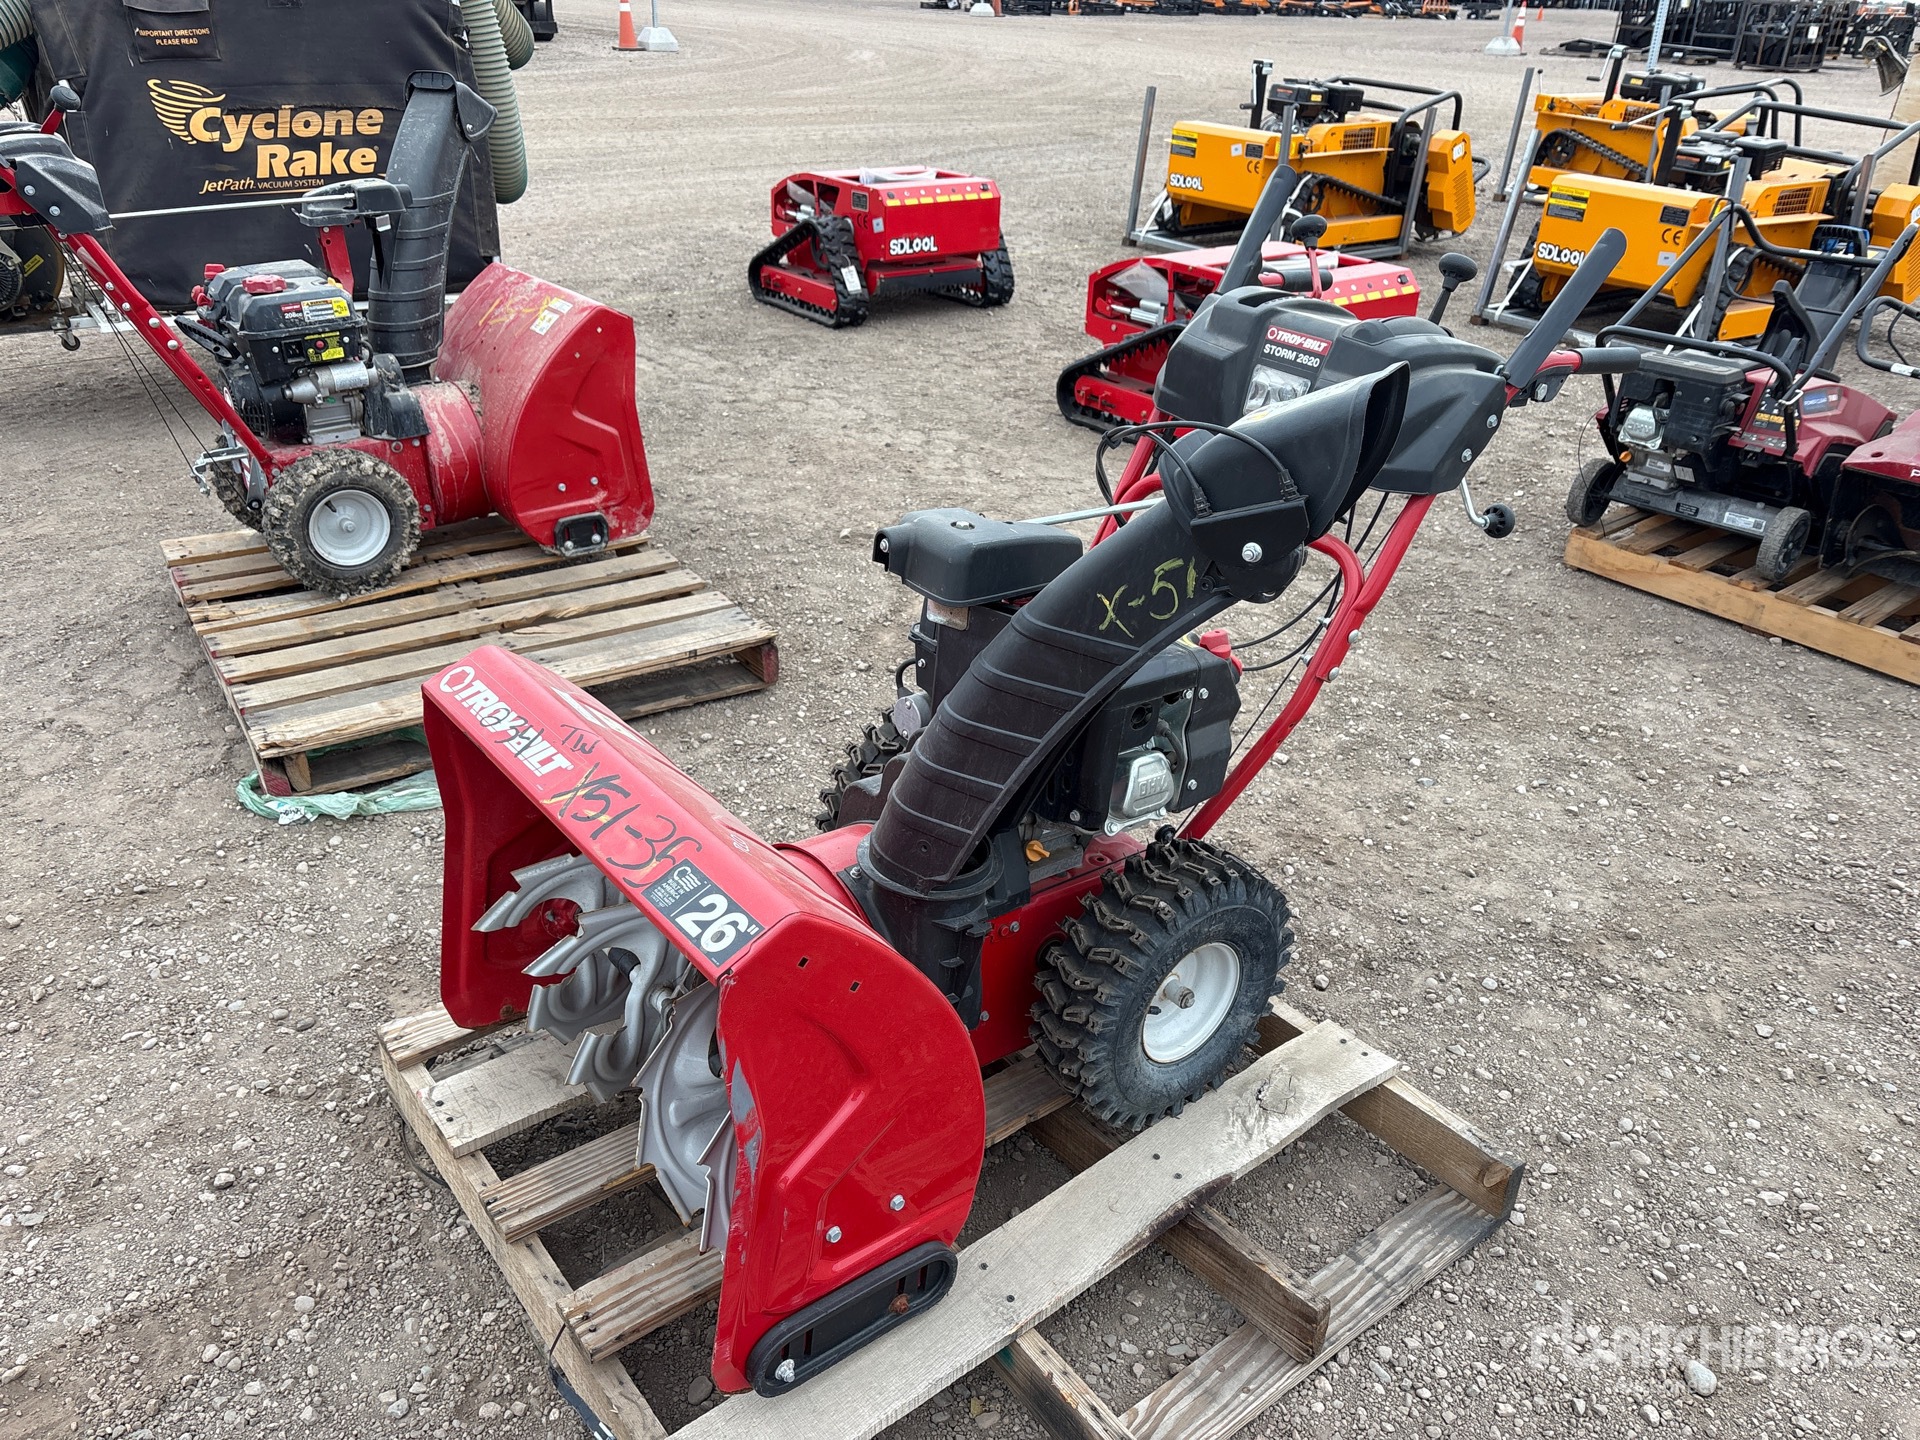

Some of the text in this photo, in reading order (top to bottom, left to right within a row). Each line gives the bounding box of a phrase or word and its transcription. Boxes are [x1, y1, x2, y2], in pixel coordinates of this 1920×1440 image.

[139, 27, 210, 37] IMPORTANT DIRECTIONS
[155, 37, 199, 46] PLEASE READ
[189, 104, 384, 153] Cyclone
[256, 141, 377, 179] Rake
[257, 180, 293, 190] VACUUM
[293, 178, 325, 188] SYSTEM
[1169, 173, 1204, 191] SDLOOL
[889, 235, 938, 256] SDLOOL
[1276, 330, 1328, 352] TROY-BILT
[1263, 343, 1320, 368] STORM 2620
[1096, 556, 1199, 639] X-51
[453, 679, 573, 777] TROY-BILT
[660, 881, 681, 900] AMERICA
[665, 878, 680, 891] BUILT
[674, 893, 760, 953] 26"
